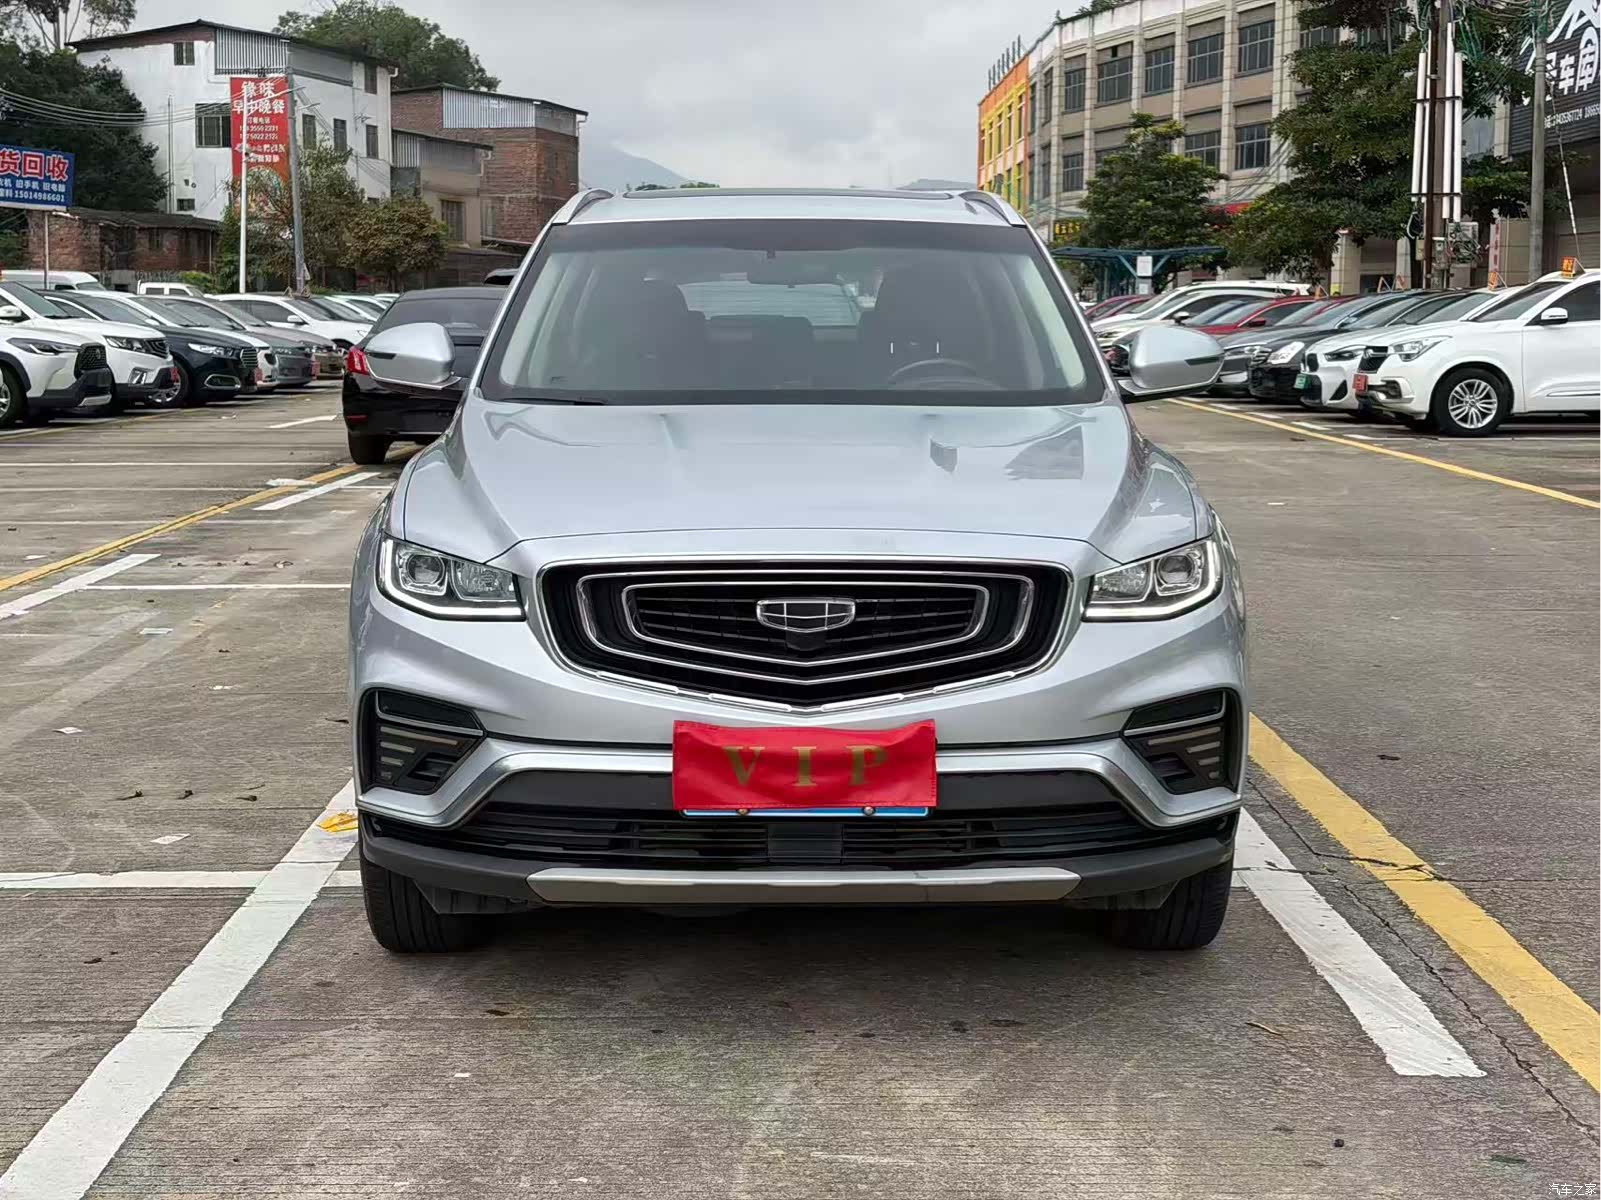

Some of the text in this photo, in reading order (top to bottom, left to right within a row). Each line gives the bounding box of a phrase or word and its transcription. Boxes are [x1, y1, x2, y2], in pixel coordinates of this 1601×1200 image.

[0, 148, 69, 181] 货回收
[722, 745, 888, 787] VIP
